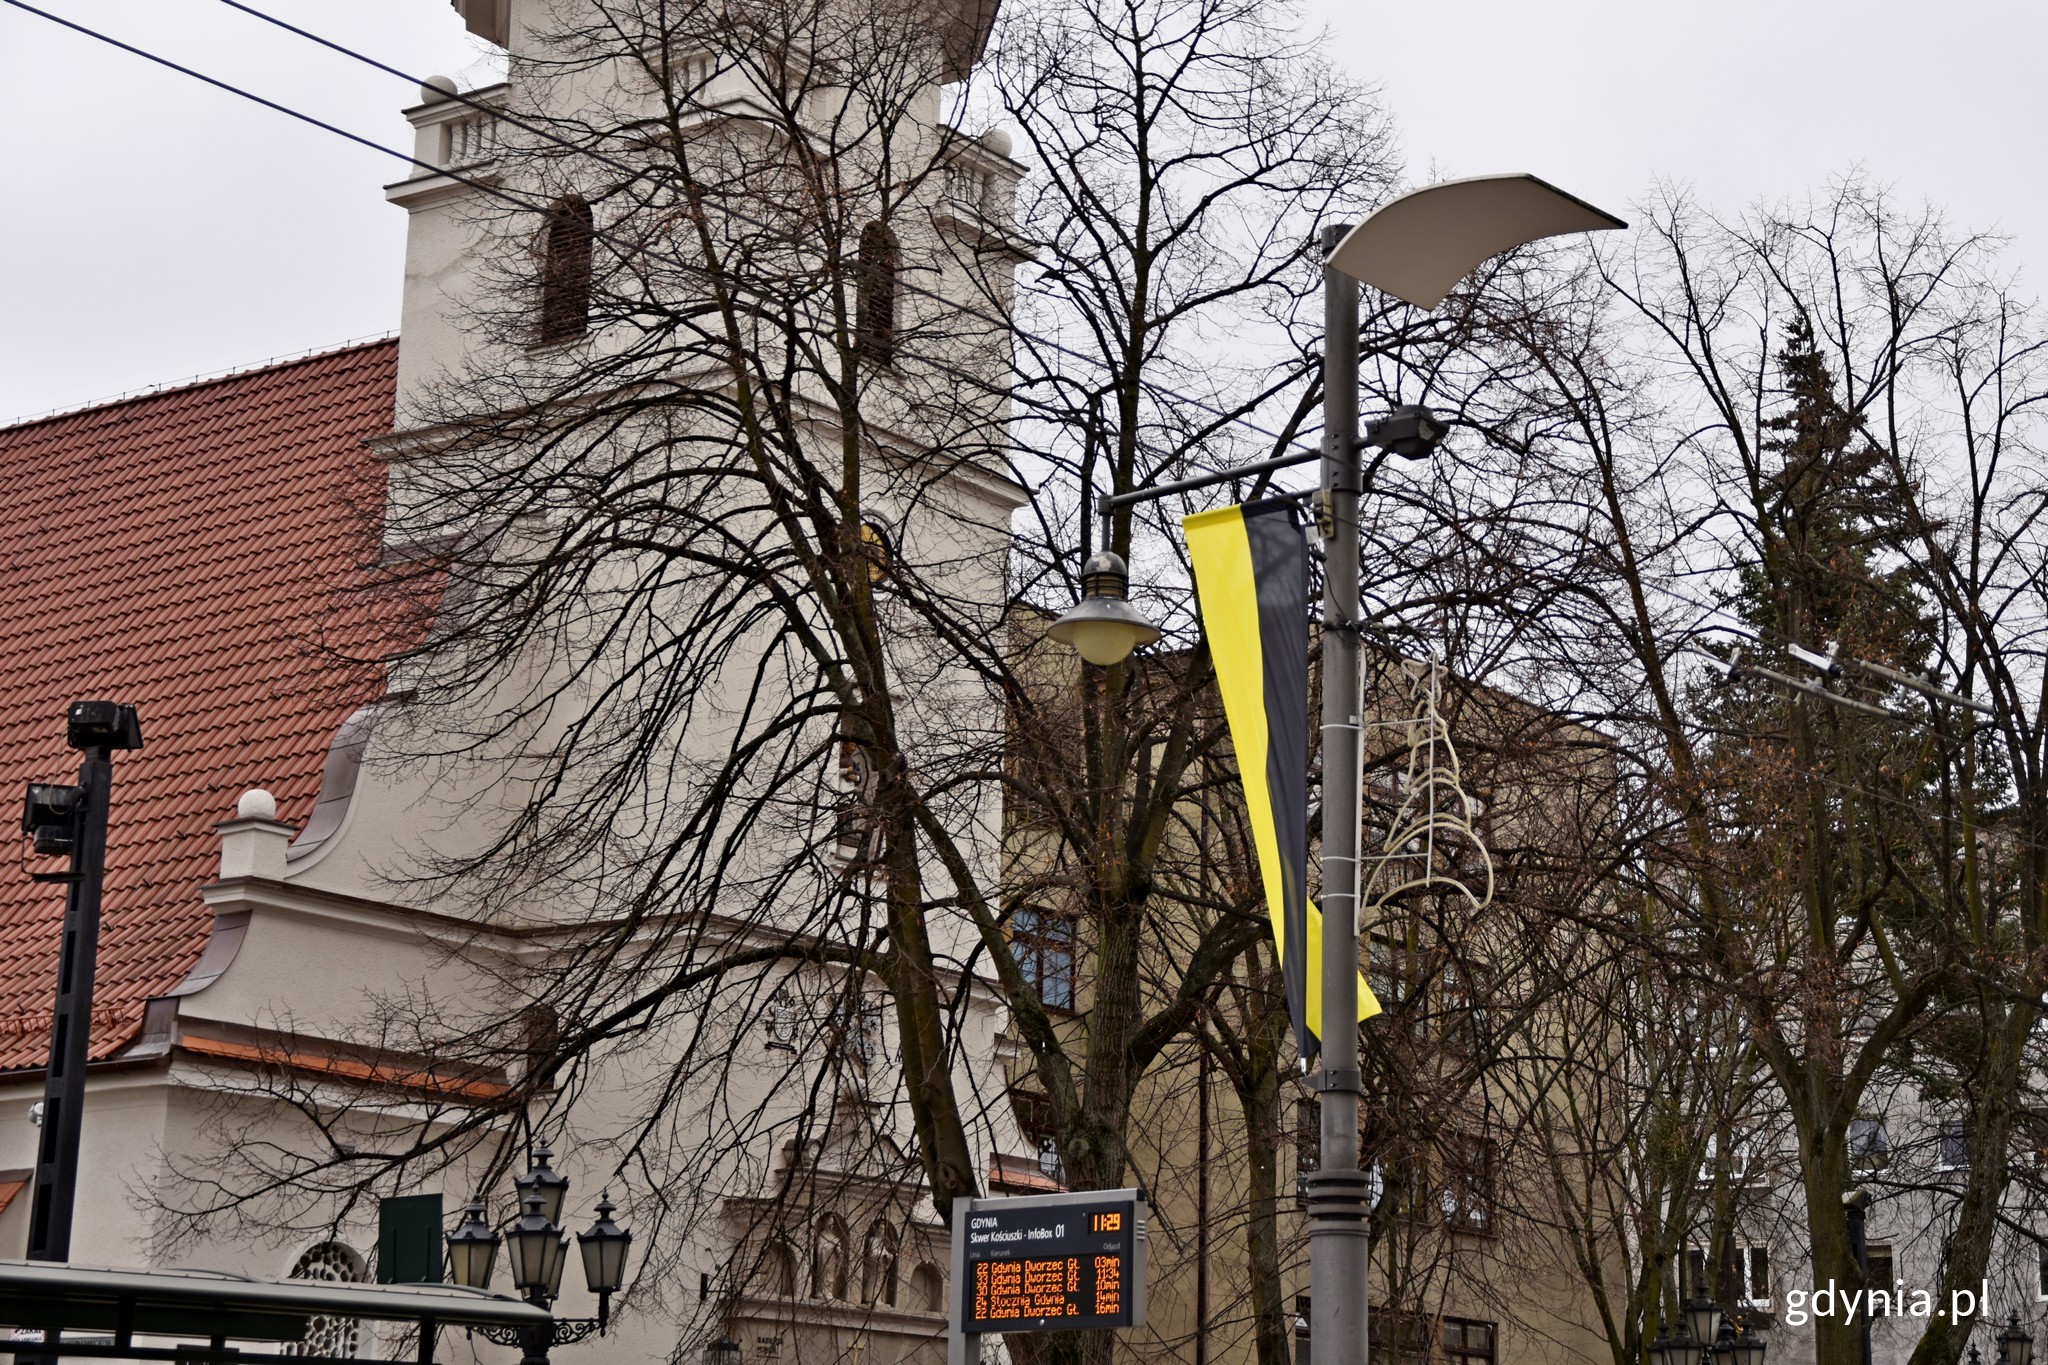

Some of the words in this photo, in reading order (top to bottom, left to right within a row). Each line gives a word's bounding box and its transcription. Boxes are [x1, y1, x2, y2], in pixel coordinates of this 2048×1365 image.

[970, 1216, 998, 1229] GDYNIA
[1094, 1213, 1120, 1232] 11:29
[970, 1232, 990, 1244] Skwer
[990, 1229, 1023, 1242] Kościuszki
[1028, 1228, 1053, 1240] InfoBox
[1055, 1224, 1065, 1238] 01
[990, 1249, 1011, 1257] Kierunek
[1103, 1242, 1120, 1251] Odjazd
[977, 1263, 988, 1274] 22
[992, 1261, 1021, 1274] Gdynia
[1024, 1260, 1064, 1272] Dworzec
[1094, 1256, 1120, 1268] 03min
[976, 1274, 988, 1285] 33
[991, 1273, 1020, 1284] Gdynia
[1024, 1272, 1064, 1283] Dworzec
[1096, 1268, 1120, 1279] 11:34
[976, 1285, 988, 1296] 30
[991, 1284, 1020, 1295] Gdynia
[1024, 1282, 1063, 1294] Dworzec
[1096, 1279, 1120, 1290] 10min
[976, 1296, 987, 1307] 24
[990, 1294, 1030, 1306] Stocznia
[1034, 1292, 1065, 1305] Gdynia
[1096, 1290, 1120, 1302] 14min
[976, 1308, 987, 1319] 22
[990, 1306, 1020, 1318] Gdynia
[1024, 1305, 1062, 1317] Dworzec
[1096, 1302, 1120, 1314] 16min
